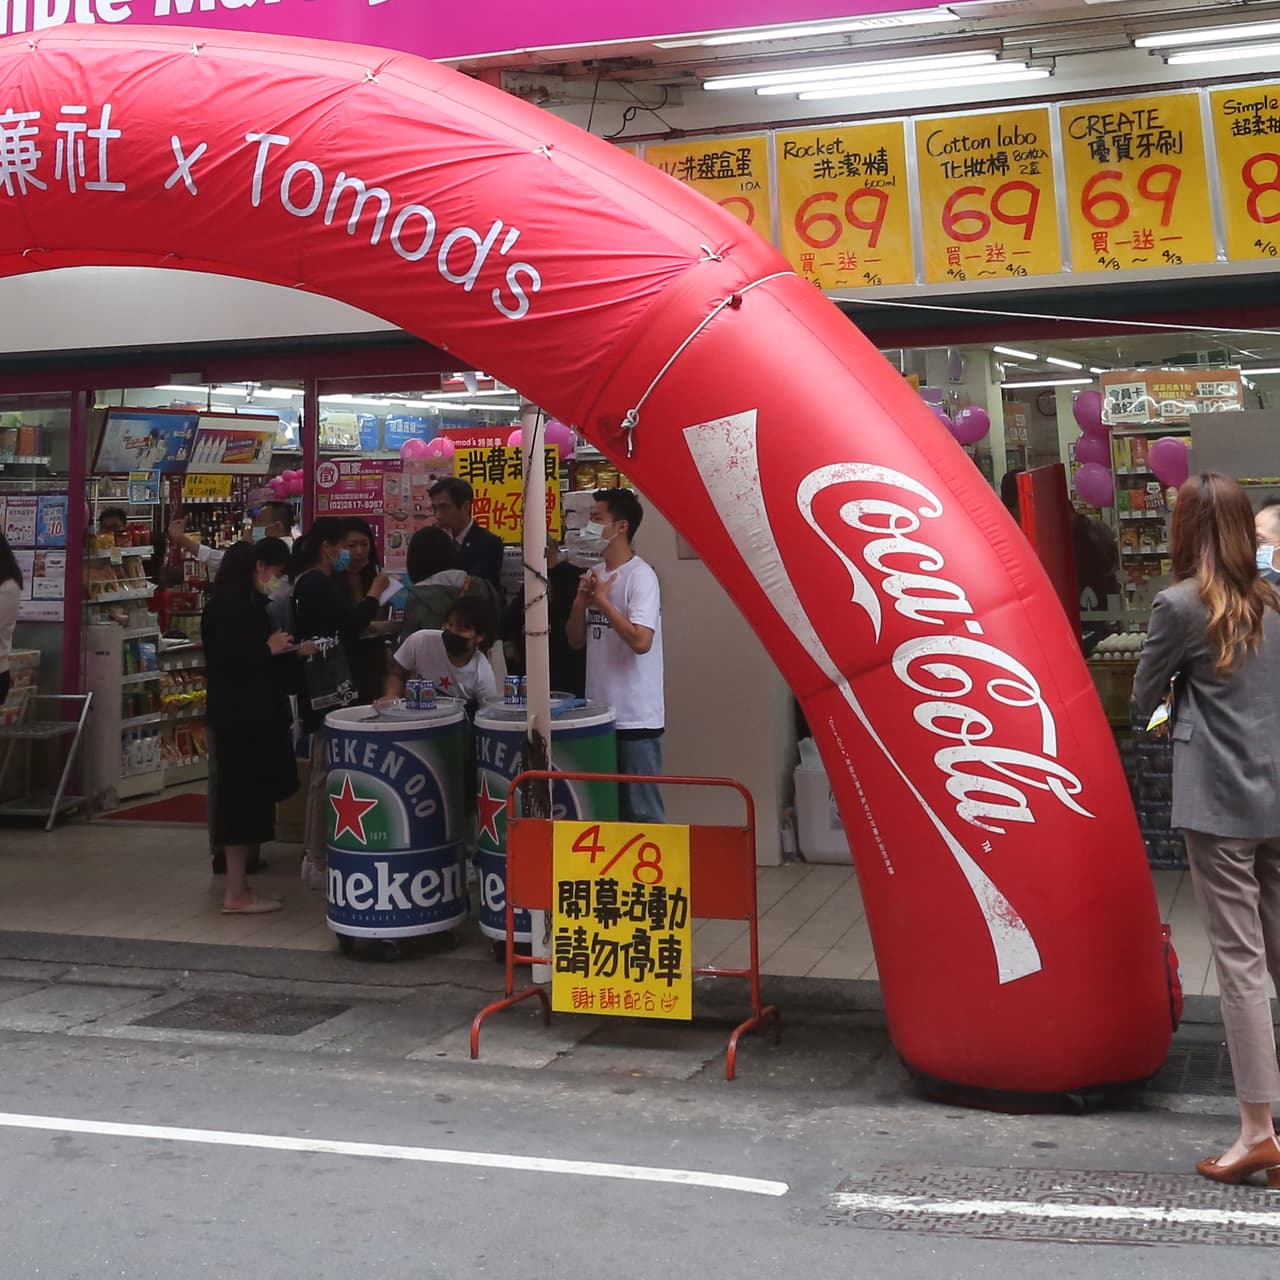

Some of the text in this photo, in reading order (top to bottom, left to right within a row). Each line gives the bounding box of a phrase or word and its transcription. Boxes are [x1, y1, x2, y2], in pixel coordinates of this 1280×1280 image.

[1223, 95, 1279, 116] Simple
[926, 124, 1037, 157] Cotton labo
[1068, 108, 1165, 141] CREATE
[783, 137, 845, 160] Rocket
[1087, 130, 1184, 164] 優質牙刷
[941, 180, 1041, 243] 69
[1080, 163, 1183, 228] 69
[245, 133, 543, 320] Tomod's
[794, 187, 890, 249] 69
[945, 243, 1032, 267] 買一送一
[1091, 228, 1184, 255] 買一送一
[800, 251, 882, 274] 買一送一
[571, 824, 664, 885] 4/8
[557, 877, 688, 932] 開幕活動
[554, 925, 683, 988] 請勿停車
[571, 986, 656, 1012] 謝謝配合
